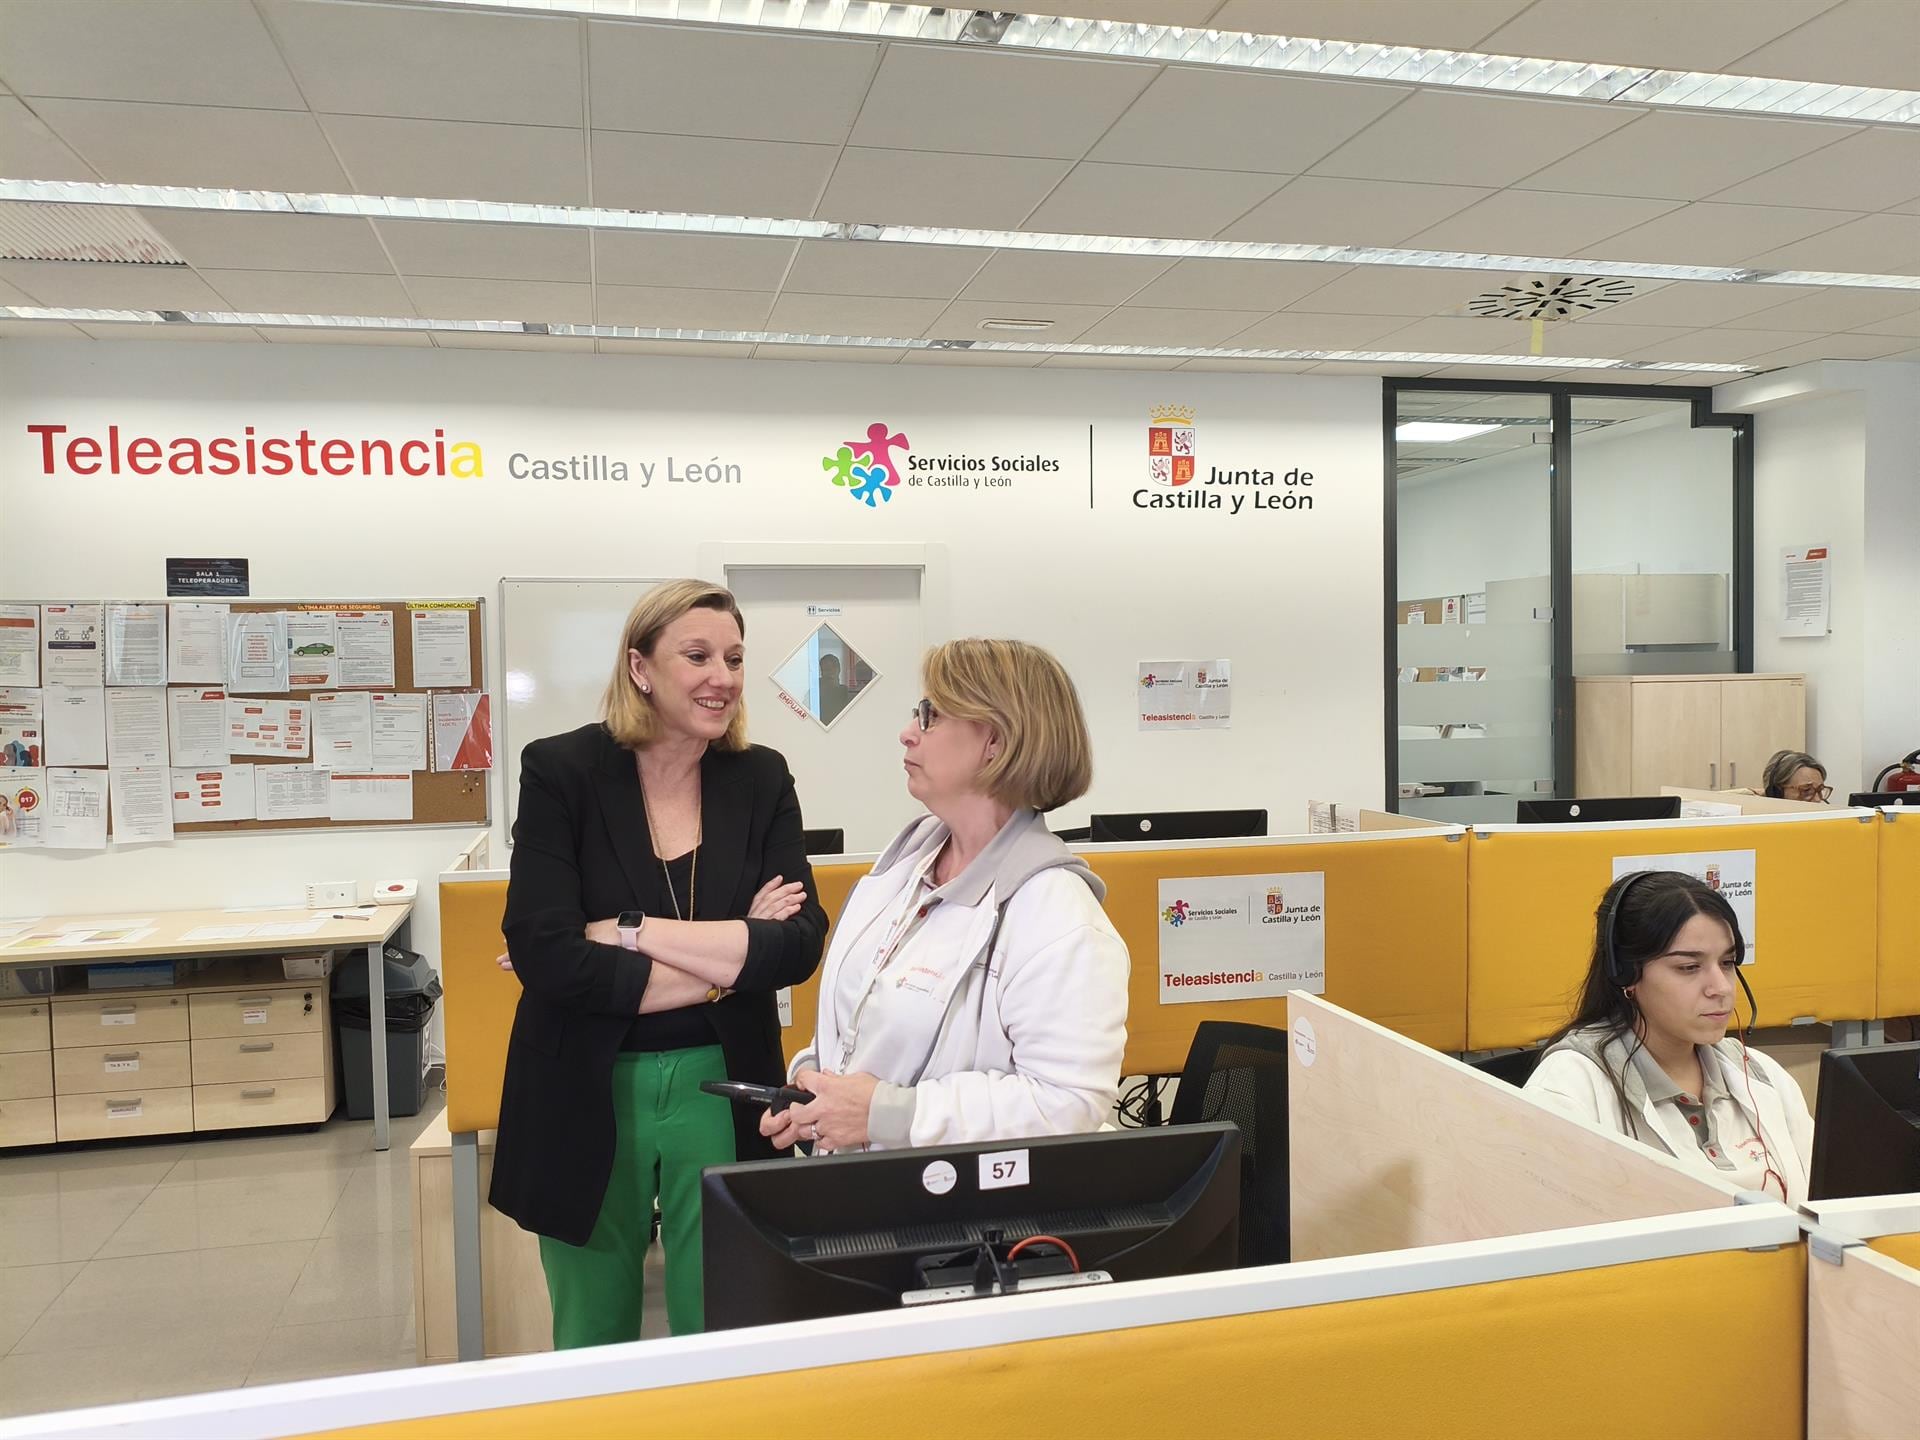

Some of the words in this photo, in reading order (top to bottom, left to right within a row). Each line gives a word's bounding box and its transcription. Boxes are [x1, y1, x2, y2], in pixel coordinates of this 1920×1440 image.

[27, 424, 485, 478] Teleasistencia
[508, 453, 629, 481] Castilla
[640, 462, 656, 488] y
[667, 456, 742, 484] León
[908, 454, 986, 471] Servicios
[992, 454, 1060, 472] Sociales
[908, 474, 923, 487] de
[927, 474, 969, 487] Castilla
[973, 477, 981, 489] y
[984, 475, 1012, 488] León
[1204, 466, 1275, 486] Junta
[1284, 468, 1314, 486] de
[1132, 489, 1222, 509] Castilla
[1230, 494, 1245, 515] y
[1254, 490, 1313, 510] León
[778, 691, 808, 720] EMPUJAR
[1142, 713, 1196, 722] Teleasistencia
[1721, 881, 1742, 889] Junta
[1743, 880, 1752, 888] de
[1728, 891, 1734, 899] y
[1735, 889, 1753, 897] León
[1214, 907, 1238, 915] Sociales
[1285, 906, 1308, 914] Junta
[1262, 915, 1292, 924] Castilla
[1293, 916, 1299, 924] y
[1300, 914, 1321, 922] León
[1164, 970, 1264, 987] Teleasistencia
[1268, 972, 1297, 981] Castilla
[1304, 971, 1324, 979] León
[992, 1160, 1017, 1180] 57
